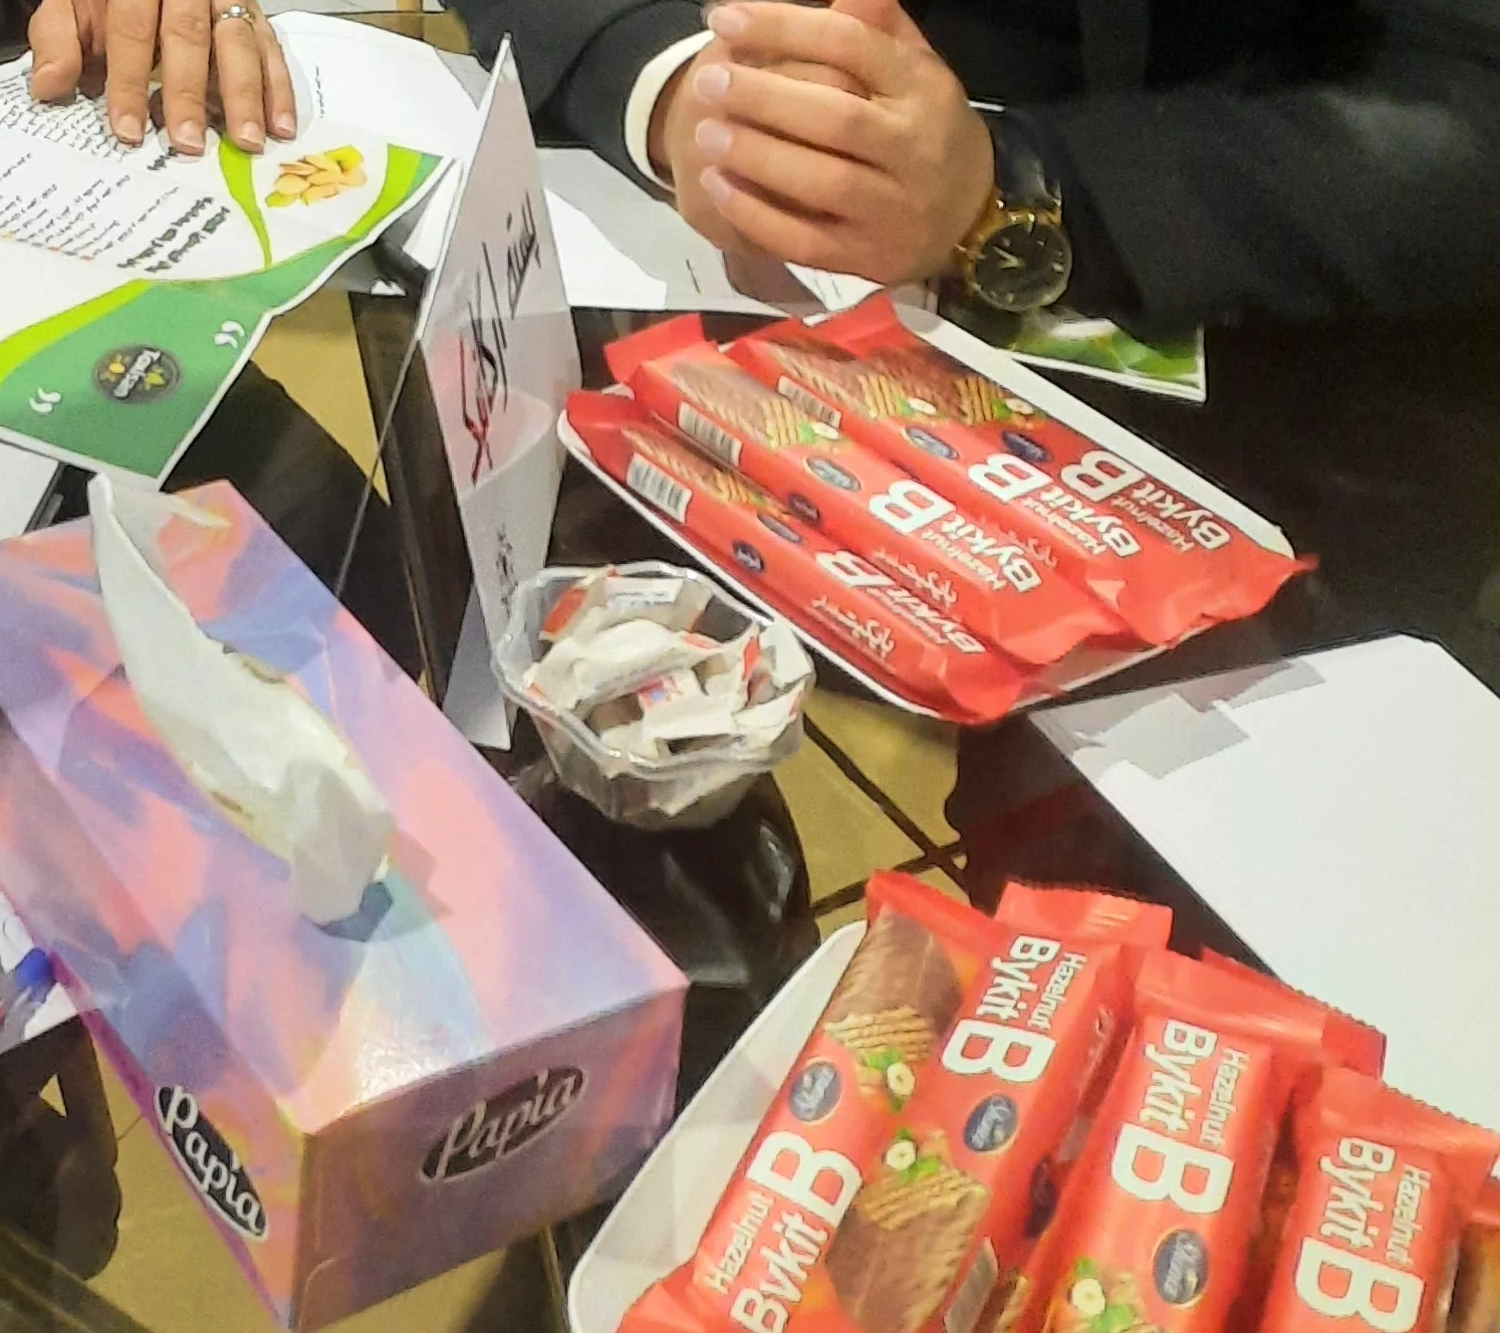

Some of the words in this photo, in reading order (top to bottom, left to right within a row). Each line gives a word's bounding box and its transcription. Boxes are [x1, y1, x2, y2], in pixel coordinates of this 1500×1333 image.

[867, 478, 956, 536] B
[967, 452, 1054, 504] B
[1039, 486, 1142, 558] Bykit
[1059, 449, 1148, 502] B
[1131, 481, 1233, 551] Bykit
[815, 549, 896, 588] B
[940, 511, 1044, 594] Bykit
[974, 934, 1062, 1022] Bykit
[1026, 951, 1088, 1031] Hazelnut
[938, 1018, 1057, 1083] B
[1137, 1019, 1219, 1133] Bykit
[1199, 1046, 1251, 1148] Hazelnut
[160, 1083, 267, 1236] Papia
[434, 1067, 583, 1181] Papia
[1110, 1120, 1236, 1215] B
[746, 1129, 863, 1229] B
[1318, 1136, 1397, 1249] Bykit
[1384, 1162, 1433, 1269] Hazelnut
[702, 1190, 776, 1296] Hazelnut
[728, 1209, 829, 1333] Bykit
[1294, 1234, 1425, 1333] B
